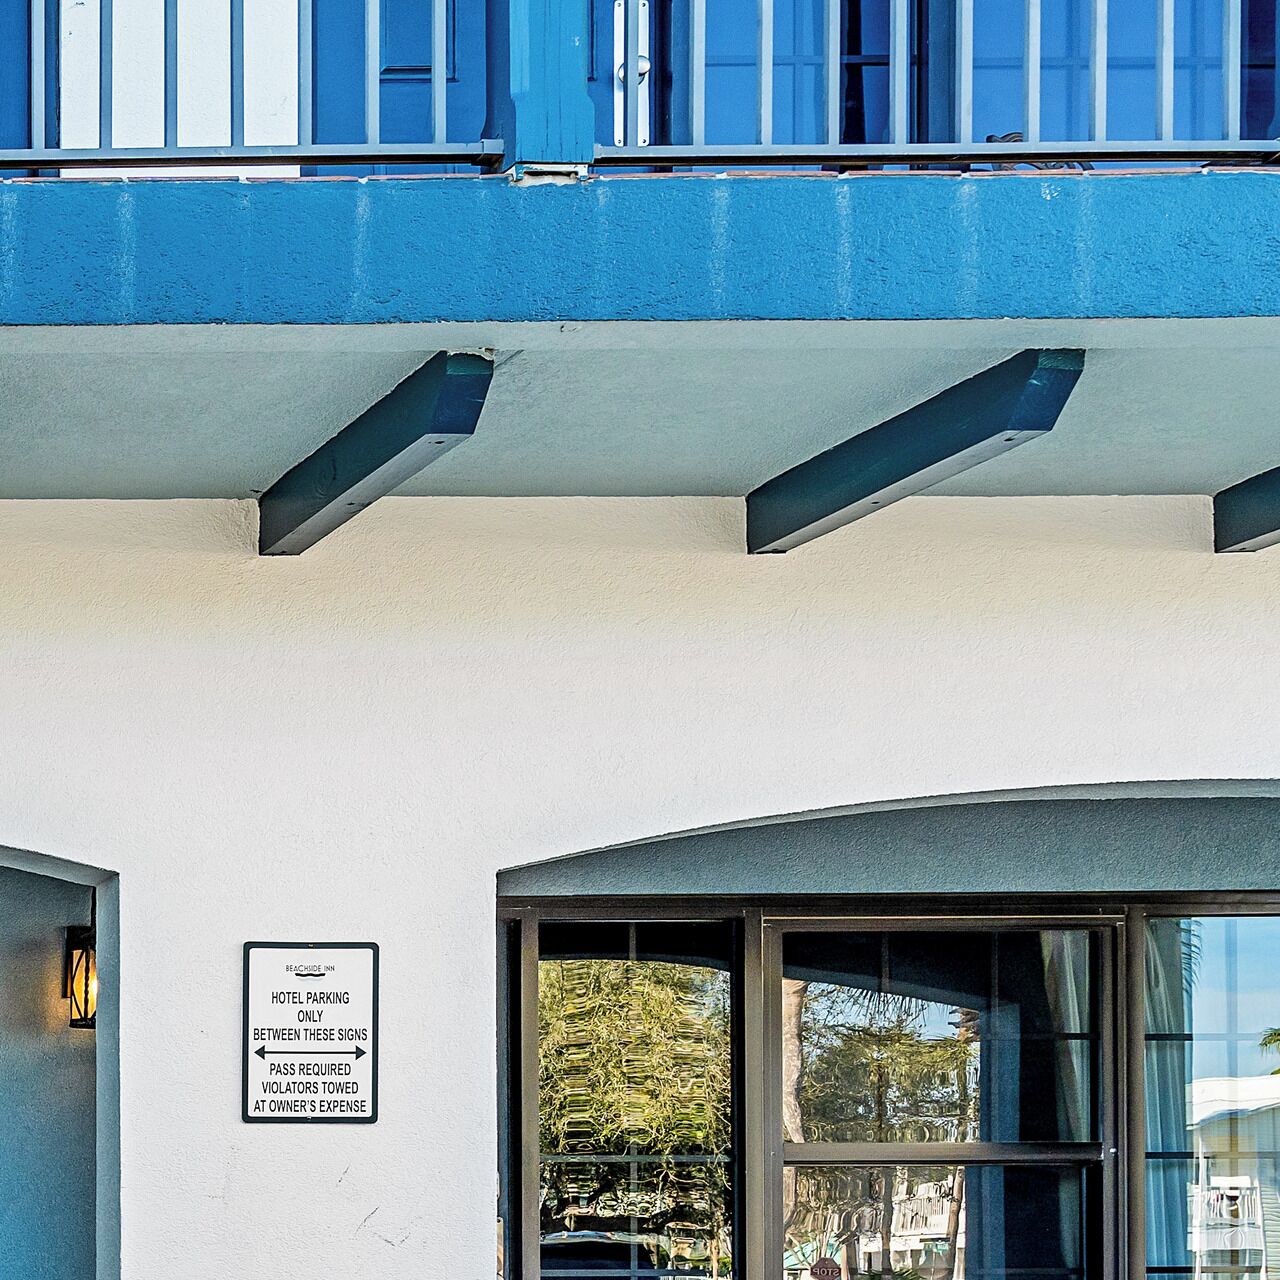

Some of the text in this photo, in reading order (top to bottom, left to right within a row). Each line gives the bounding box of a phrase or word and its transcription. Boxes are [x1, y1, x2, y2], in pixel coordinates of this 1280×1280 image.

[272, 992, 349, 1004] HOTEL PARKING
[298, 1010, 323, 1022] ONLY
[254, 1028, 367, 1041] BETWEEN THESE SIGNS
[270, 1063, 351, 1076] PASS REQUIRED
[262, 1082, 358, 1094] VIOLATORS TOWED
[254, 1100, 366, 1112] AT OWNER'S EXPENSE
